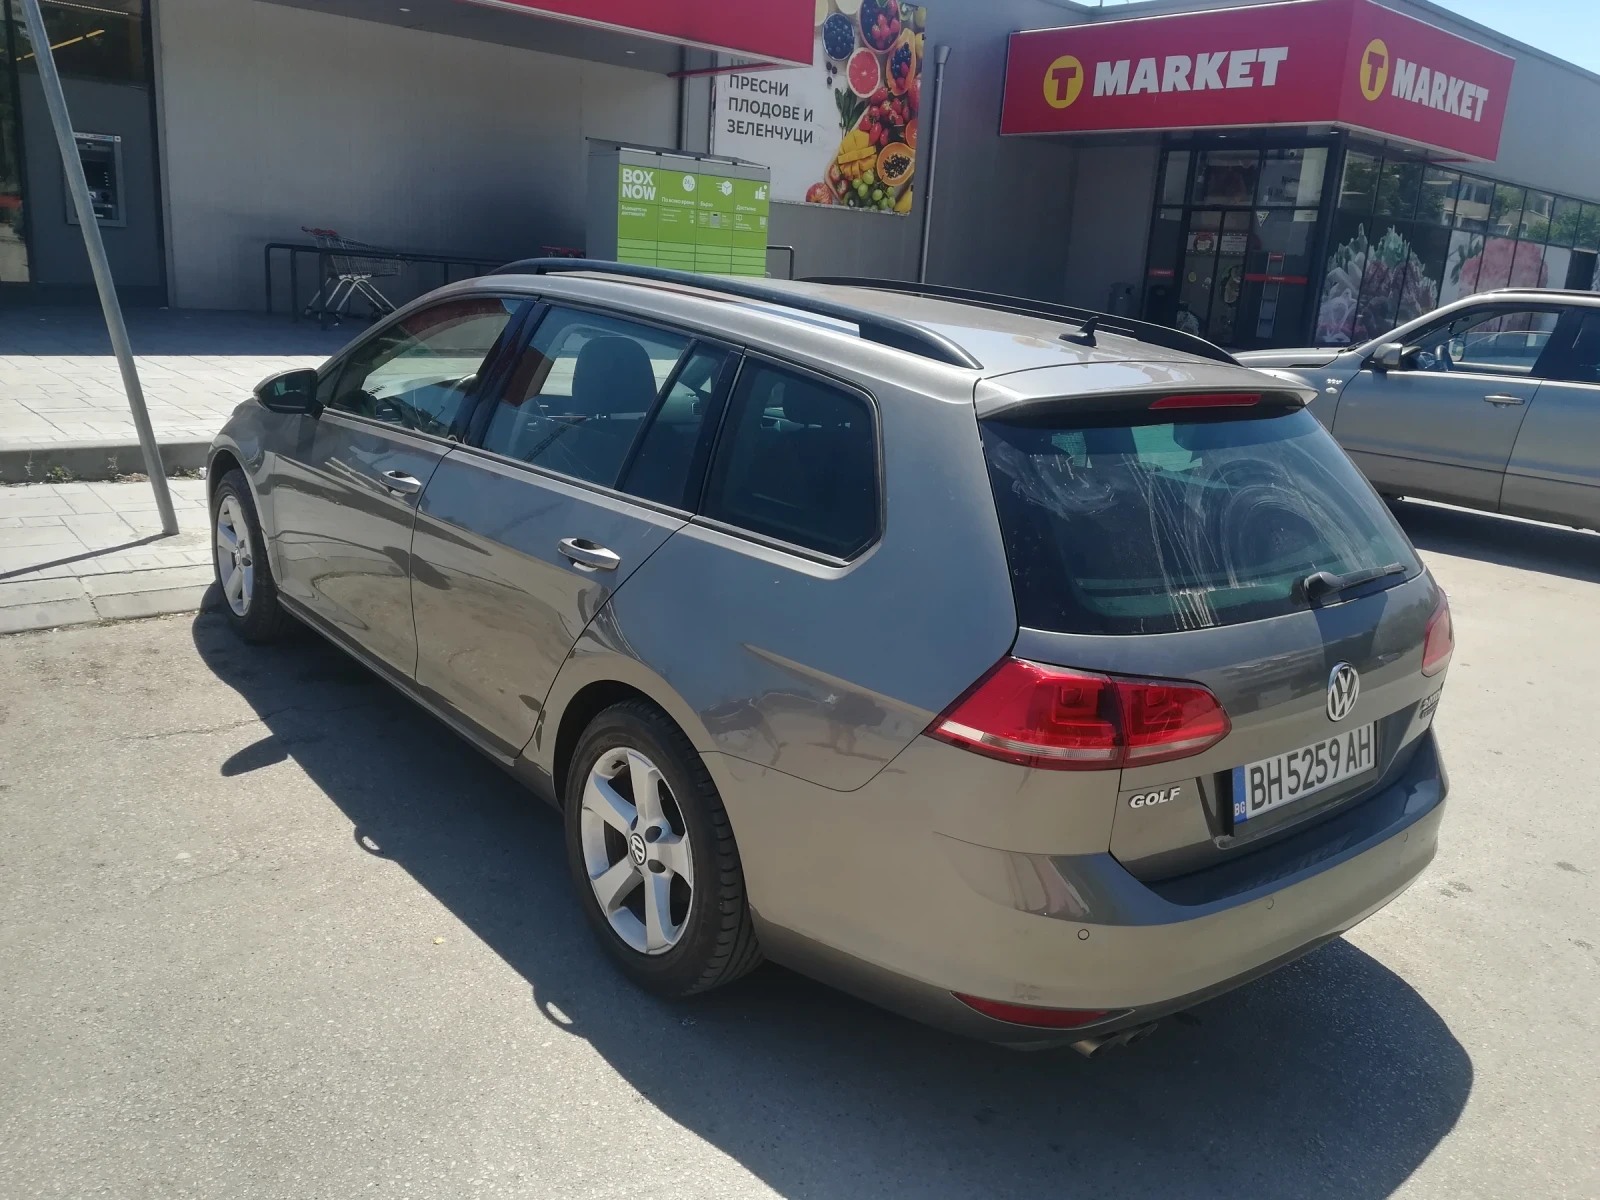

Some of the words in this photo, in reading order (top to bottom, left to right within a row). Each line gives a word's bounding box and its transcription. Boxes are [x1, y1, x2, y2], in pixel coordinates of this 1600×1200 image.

[1092, 46, 1289, 97] MARKET
[729, 74, 789, 97] ПРЕСНИ
[1391, 57, 1489, 122] MARKET
[728, 97, 800, 120] ПЛОДОВЕ
[804, 108, 813, 122] И
[727, 119, 813, 144] ЗЕЛЕНЧУЦИ
[622, 168, 654, 186] BOX
[622, 184, 656, 201] NOW
[1287, 738, 1341, 796] 5259
[1346, 725, 1371, 773] AH
[1129, 786, 1180, 809] GOLF
[1234, 801, 1246, 817] BG
